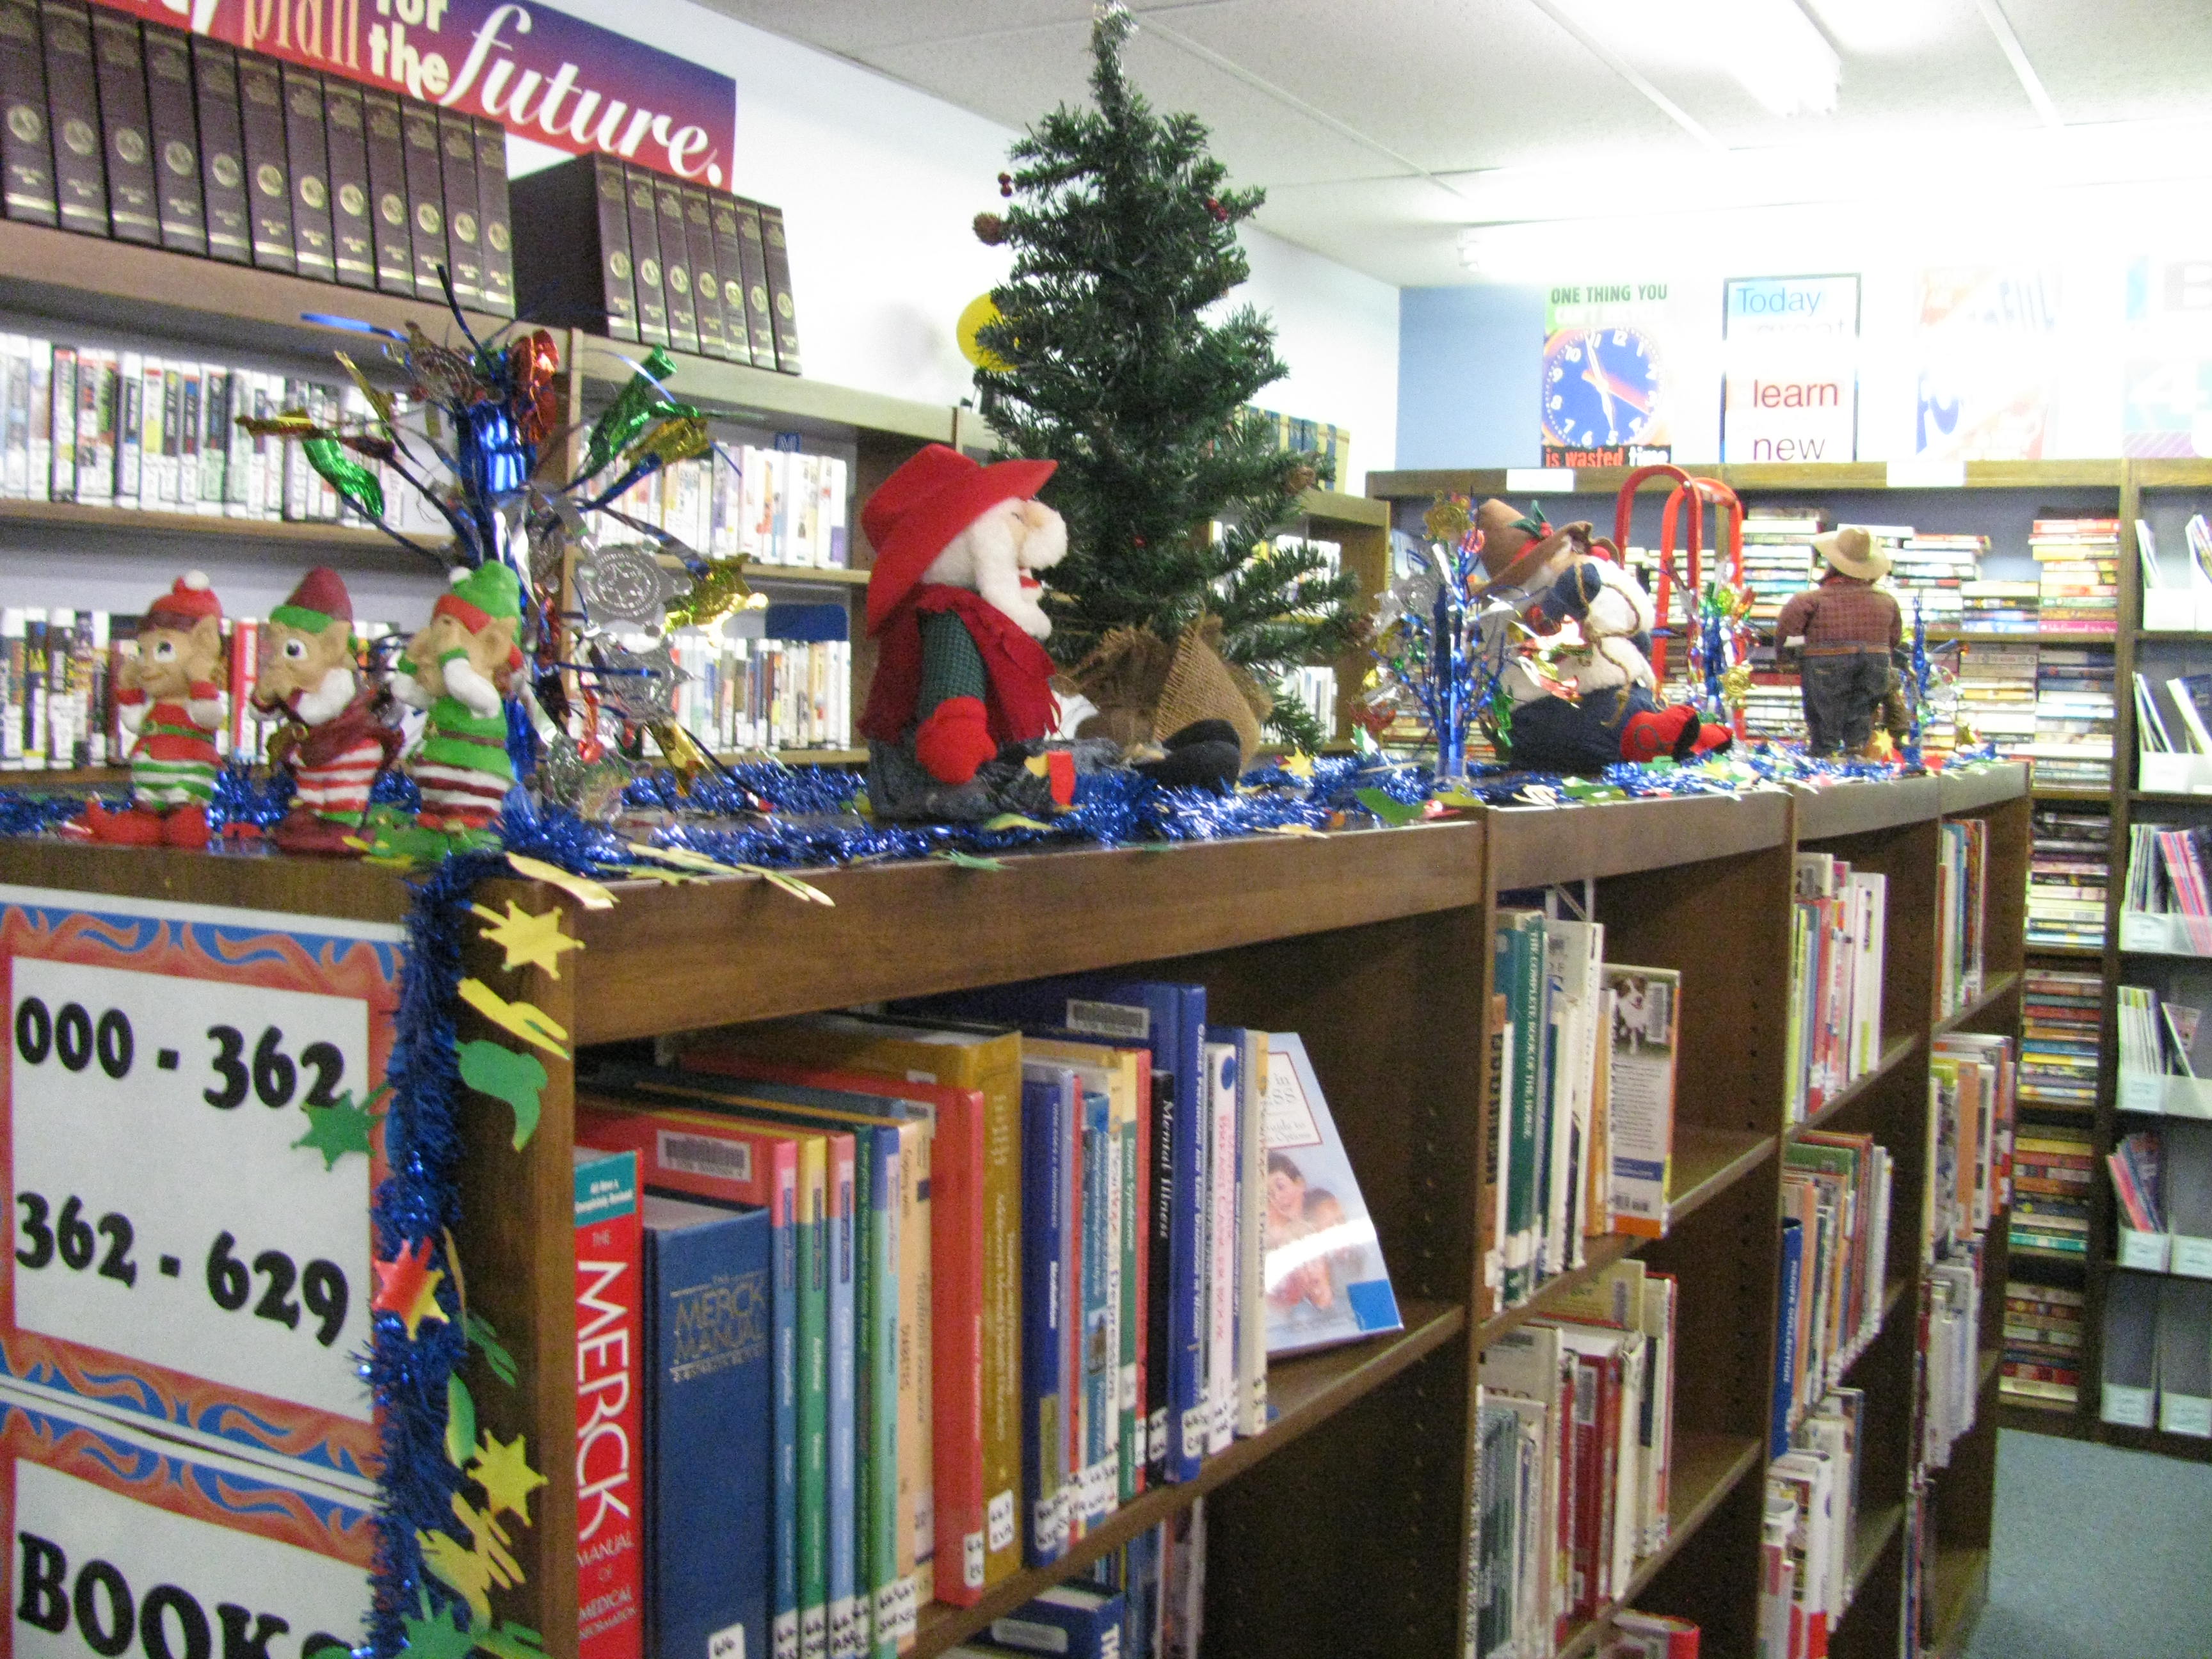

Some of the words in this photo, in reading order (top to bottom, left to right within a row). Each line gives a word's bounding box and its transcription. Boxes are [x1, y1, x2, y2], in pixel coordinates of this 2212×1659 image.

[368, 22, 449, 100] the
[440, 4, 723, 186] future.
[1551, 287, 1580, 304] ONE
[1586, 285, 1631, 302] THING
[1638, 284, 1667, 301] YOU
[1736, 287, 1822, 317] Today
[1613, 330, 1628, 347] 12
[1565, 346, 1582, 363] 10
[1551, 367, 1563, 383] 9
[1550, 394, 1562, 410] 8
[1754, 379, 1838, 408] learn
[1563, 418, 1575, 433] 7
[1581, 431, 1593, 448] 6
[1606, 430, 1619, 446] 5
[1546, 447, 1560, 467] is
[1565, 445, 1624, 467] wasted
[1628, 445, 1669, 467] time
[1754, 438, 1825, 461] new
[16, 996, 134, 1080] 000
[157, 1048, 180, 1070] -
[203, 1025, 346, 1110] 362
[1161, 1100, 1174, 1170] Mental
[1159, 1177, 1172, 1239] Illness
[15, 1191, 137, 1289] 362
[159, 1254, 180, 1278] -
[207, 1230, 349, 1348] 629
[675, 1280, 767, 1334] MERCK
[577, 1260, 630, 1541] MERCK
[577, 1530, 635, 1567] MANUAL
[17, 1531, 353, 1659] BOOK
[579, 1585, 632, 1623] MEDICAL
